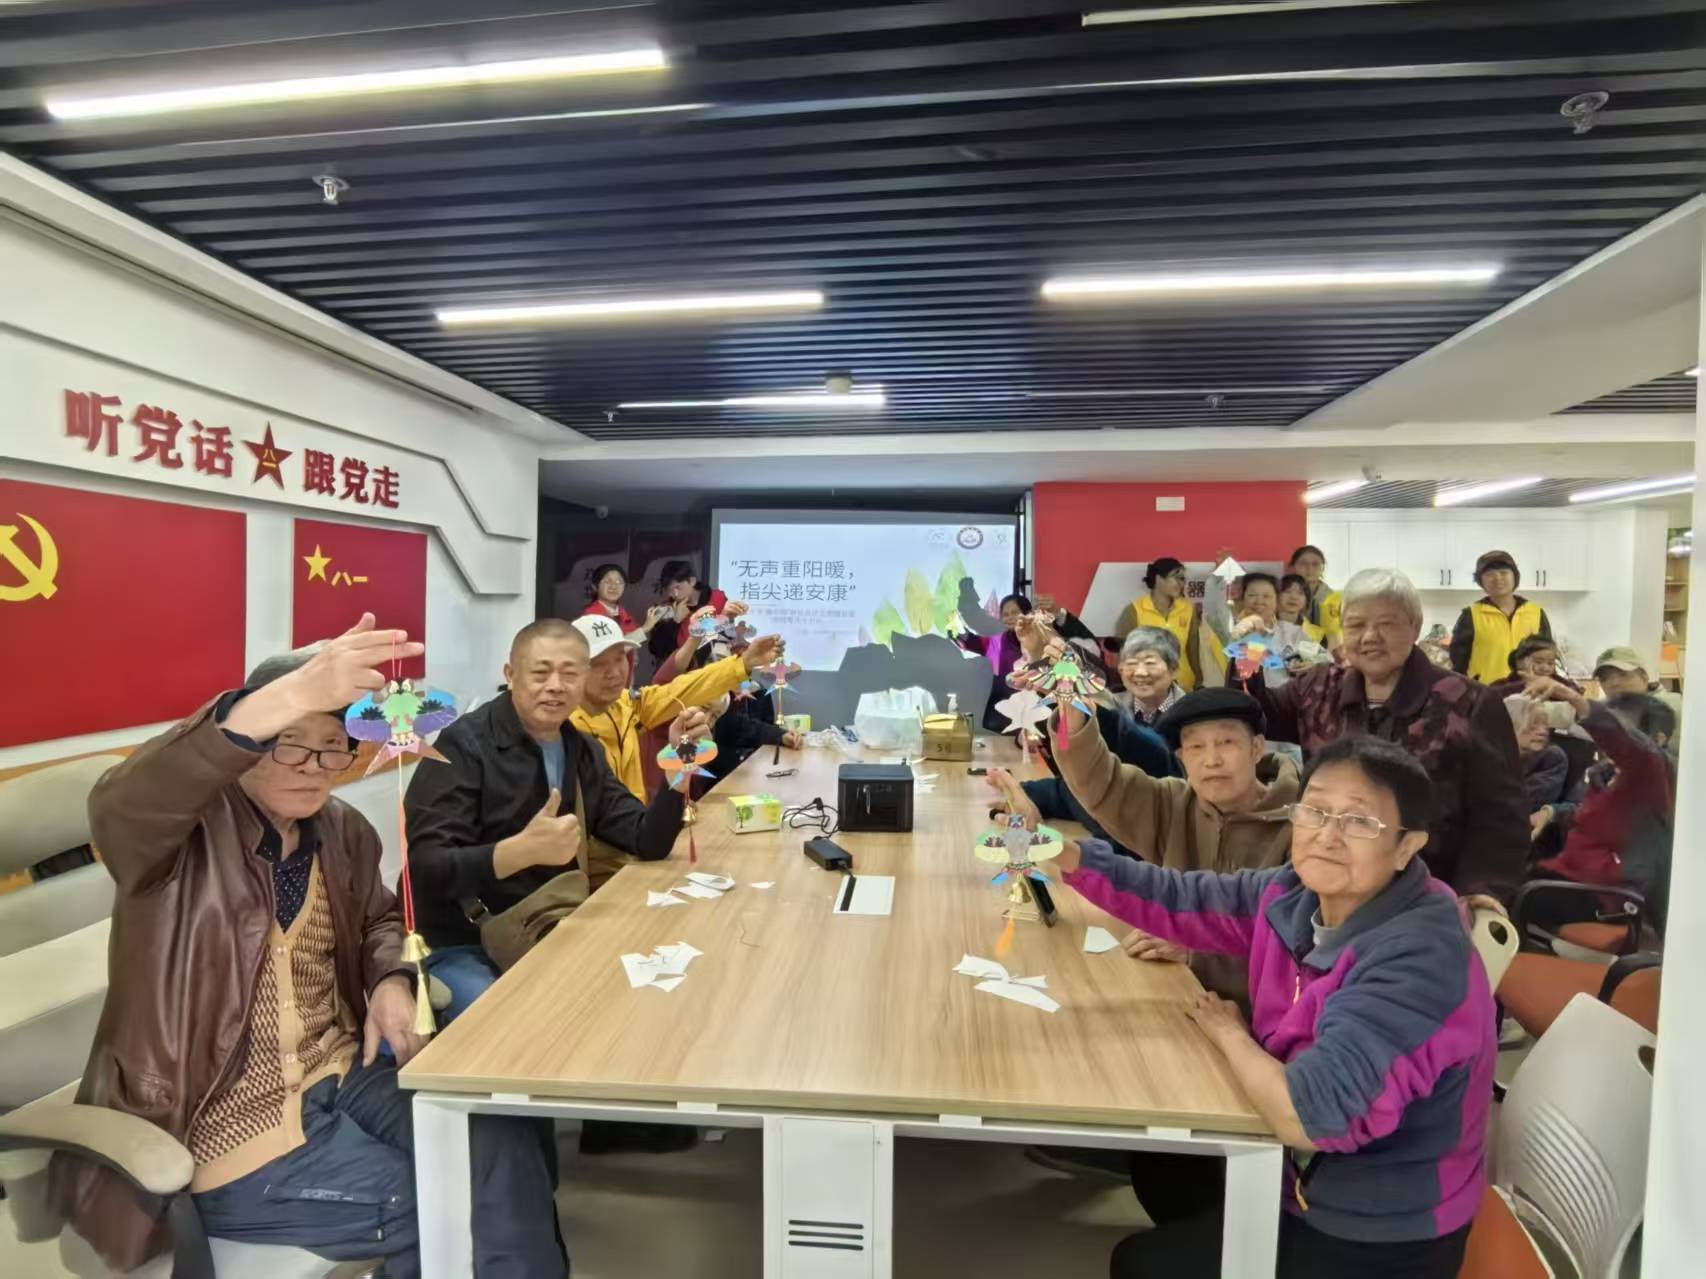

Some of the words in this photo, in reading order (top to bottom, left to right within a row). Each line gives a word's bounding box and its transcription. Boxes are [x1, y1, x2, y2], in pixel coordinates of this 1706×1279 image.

[64, 388, 233, 478] 听党话
[304, 447, 400, 509] 跟党走
[331, 570, 369, 587] 八一
